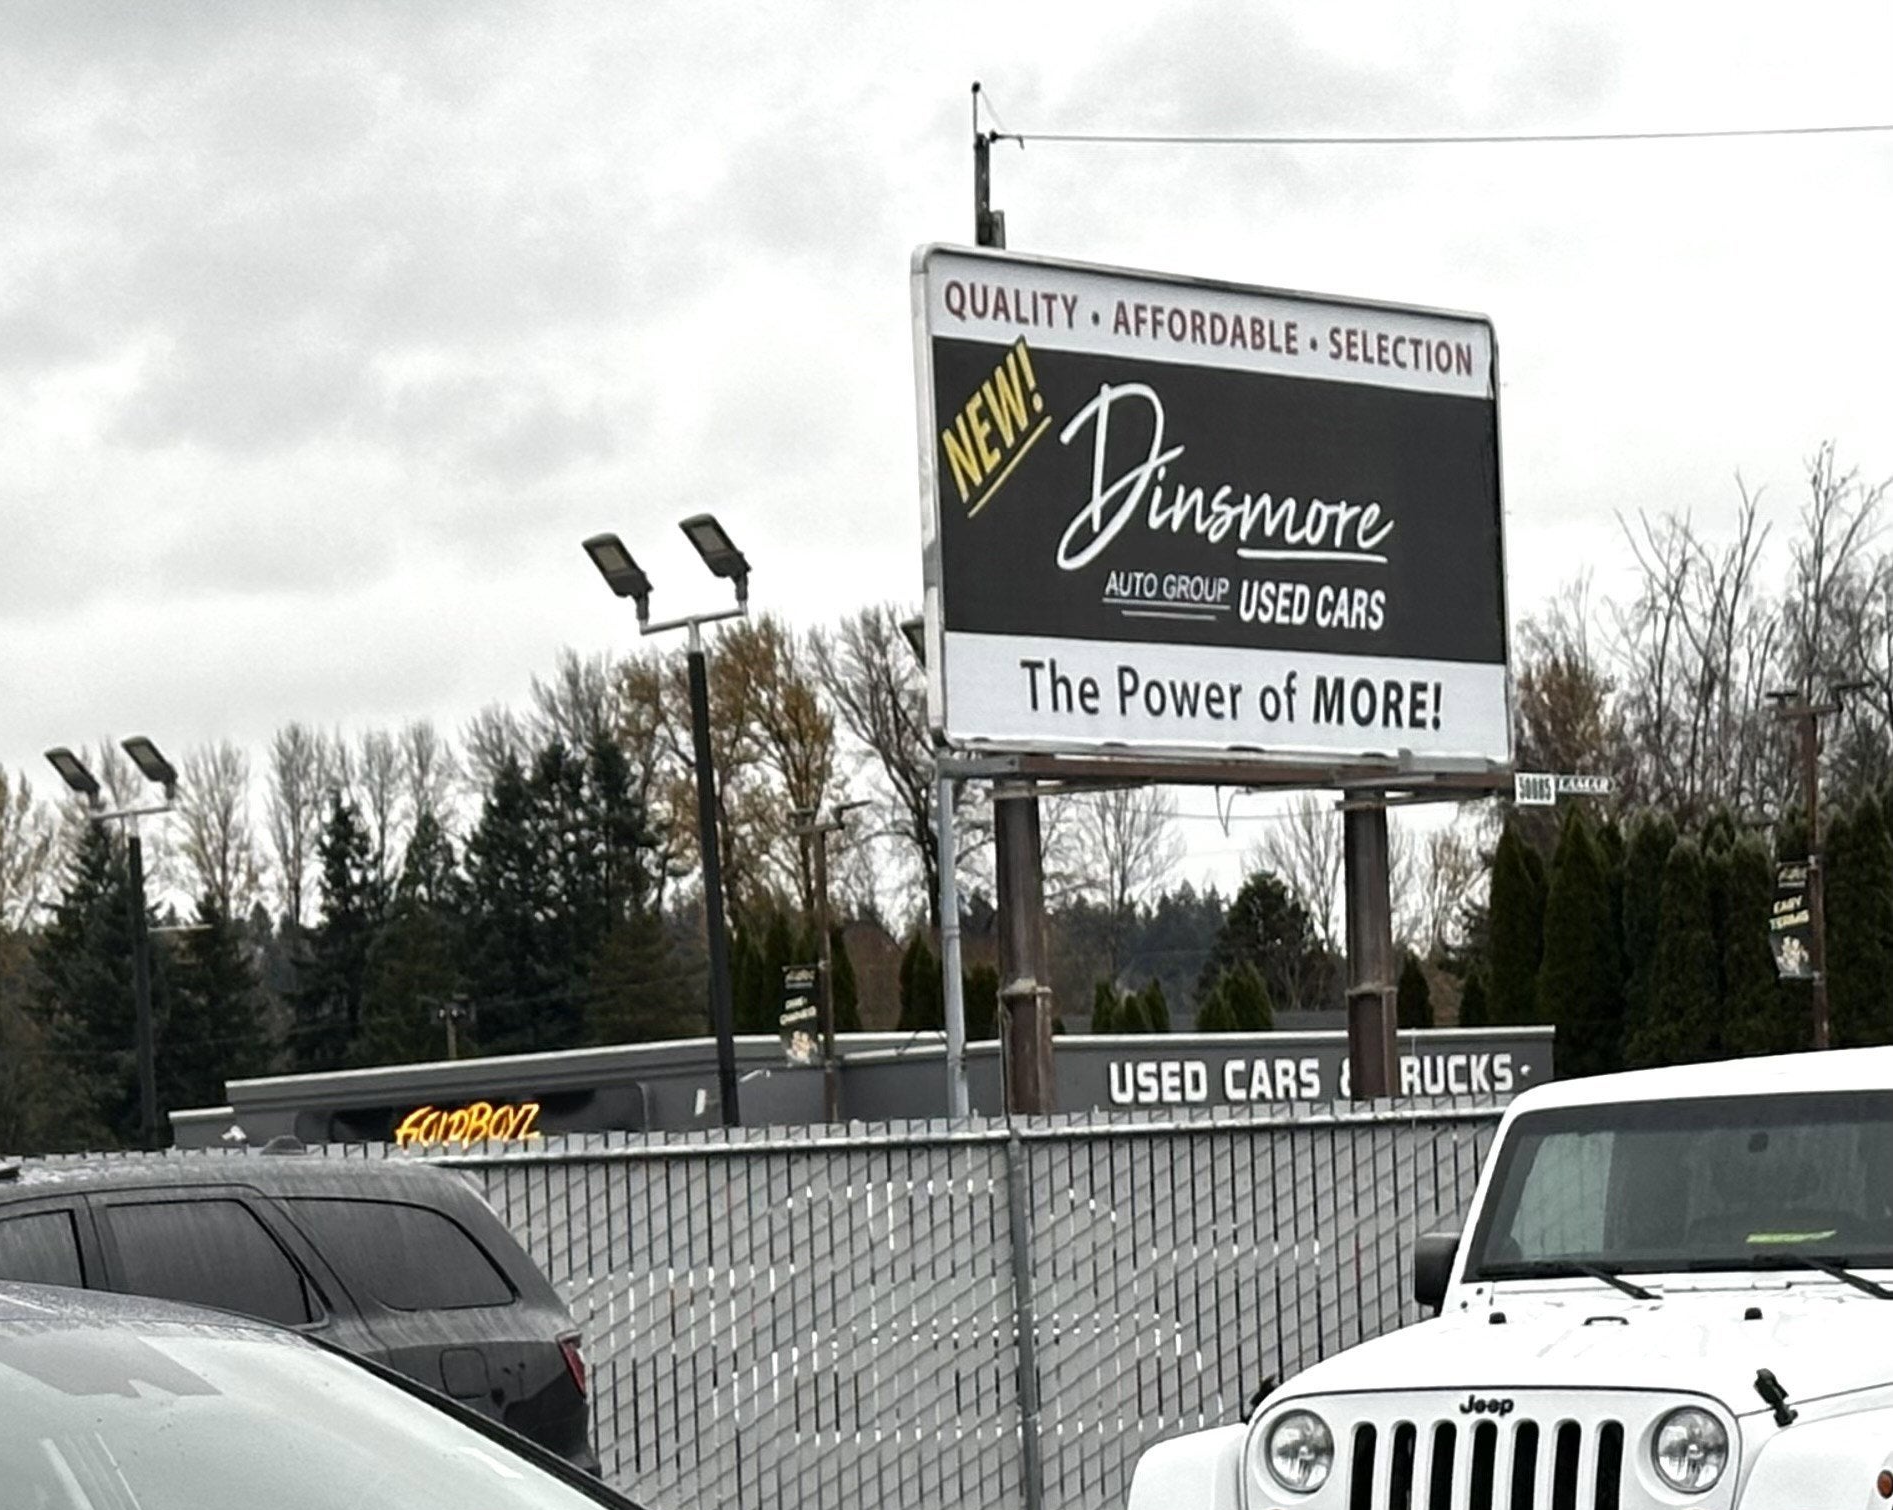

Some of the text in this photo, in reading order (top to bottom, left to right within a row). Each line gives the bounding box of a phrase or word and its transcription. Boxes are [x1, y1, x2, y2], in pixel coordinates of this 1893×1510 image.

[944, 280, 1474, 376] QUALITY AFFORDABLE SELECTION
[941, 334, 1046, 503] NEW!
[1056, 383, 1394, 572] Dinsmore
[1105, 571, 1386, 631] AUTO GROUP USED CARS
[1020, 660, 1443, 730] The Power of MORE!
[1108, 1059, 1208, 1104] USED
[1224, 1057, 1321, 1101] CARS
[1400, 1053, 1513, 1096] RUCKS
[1459, 1394, 1515, 1418] Jeep
